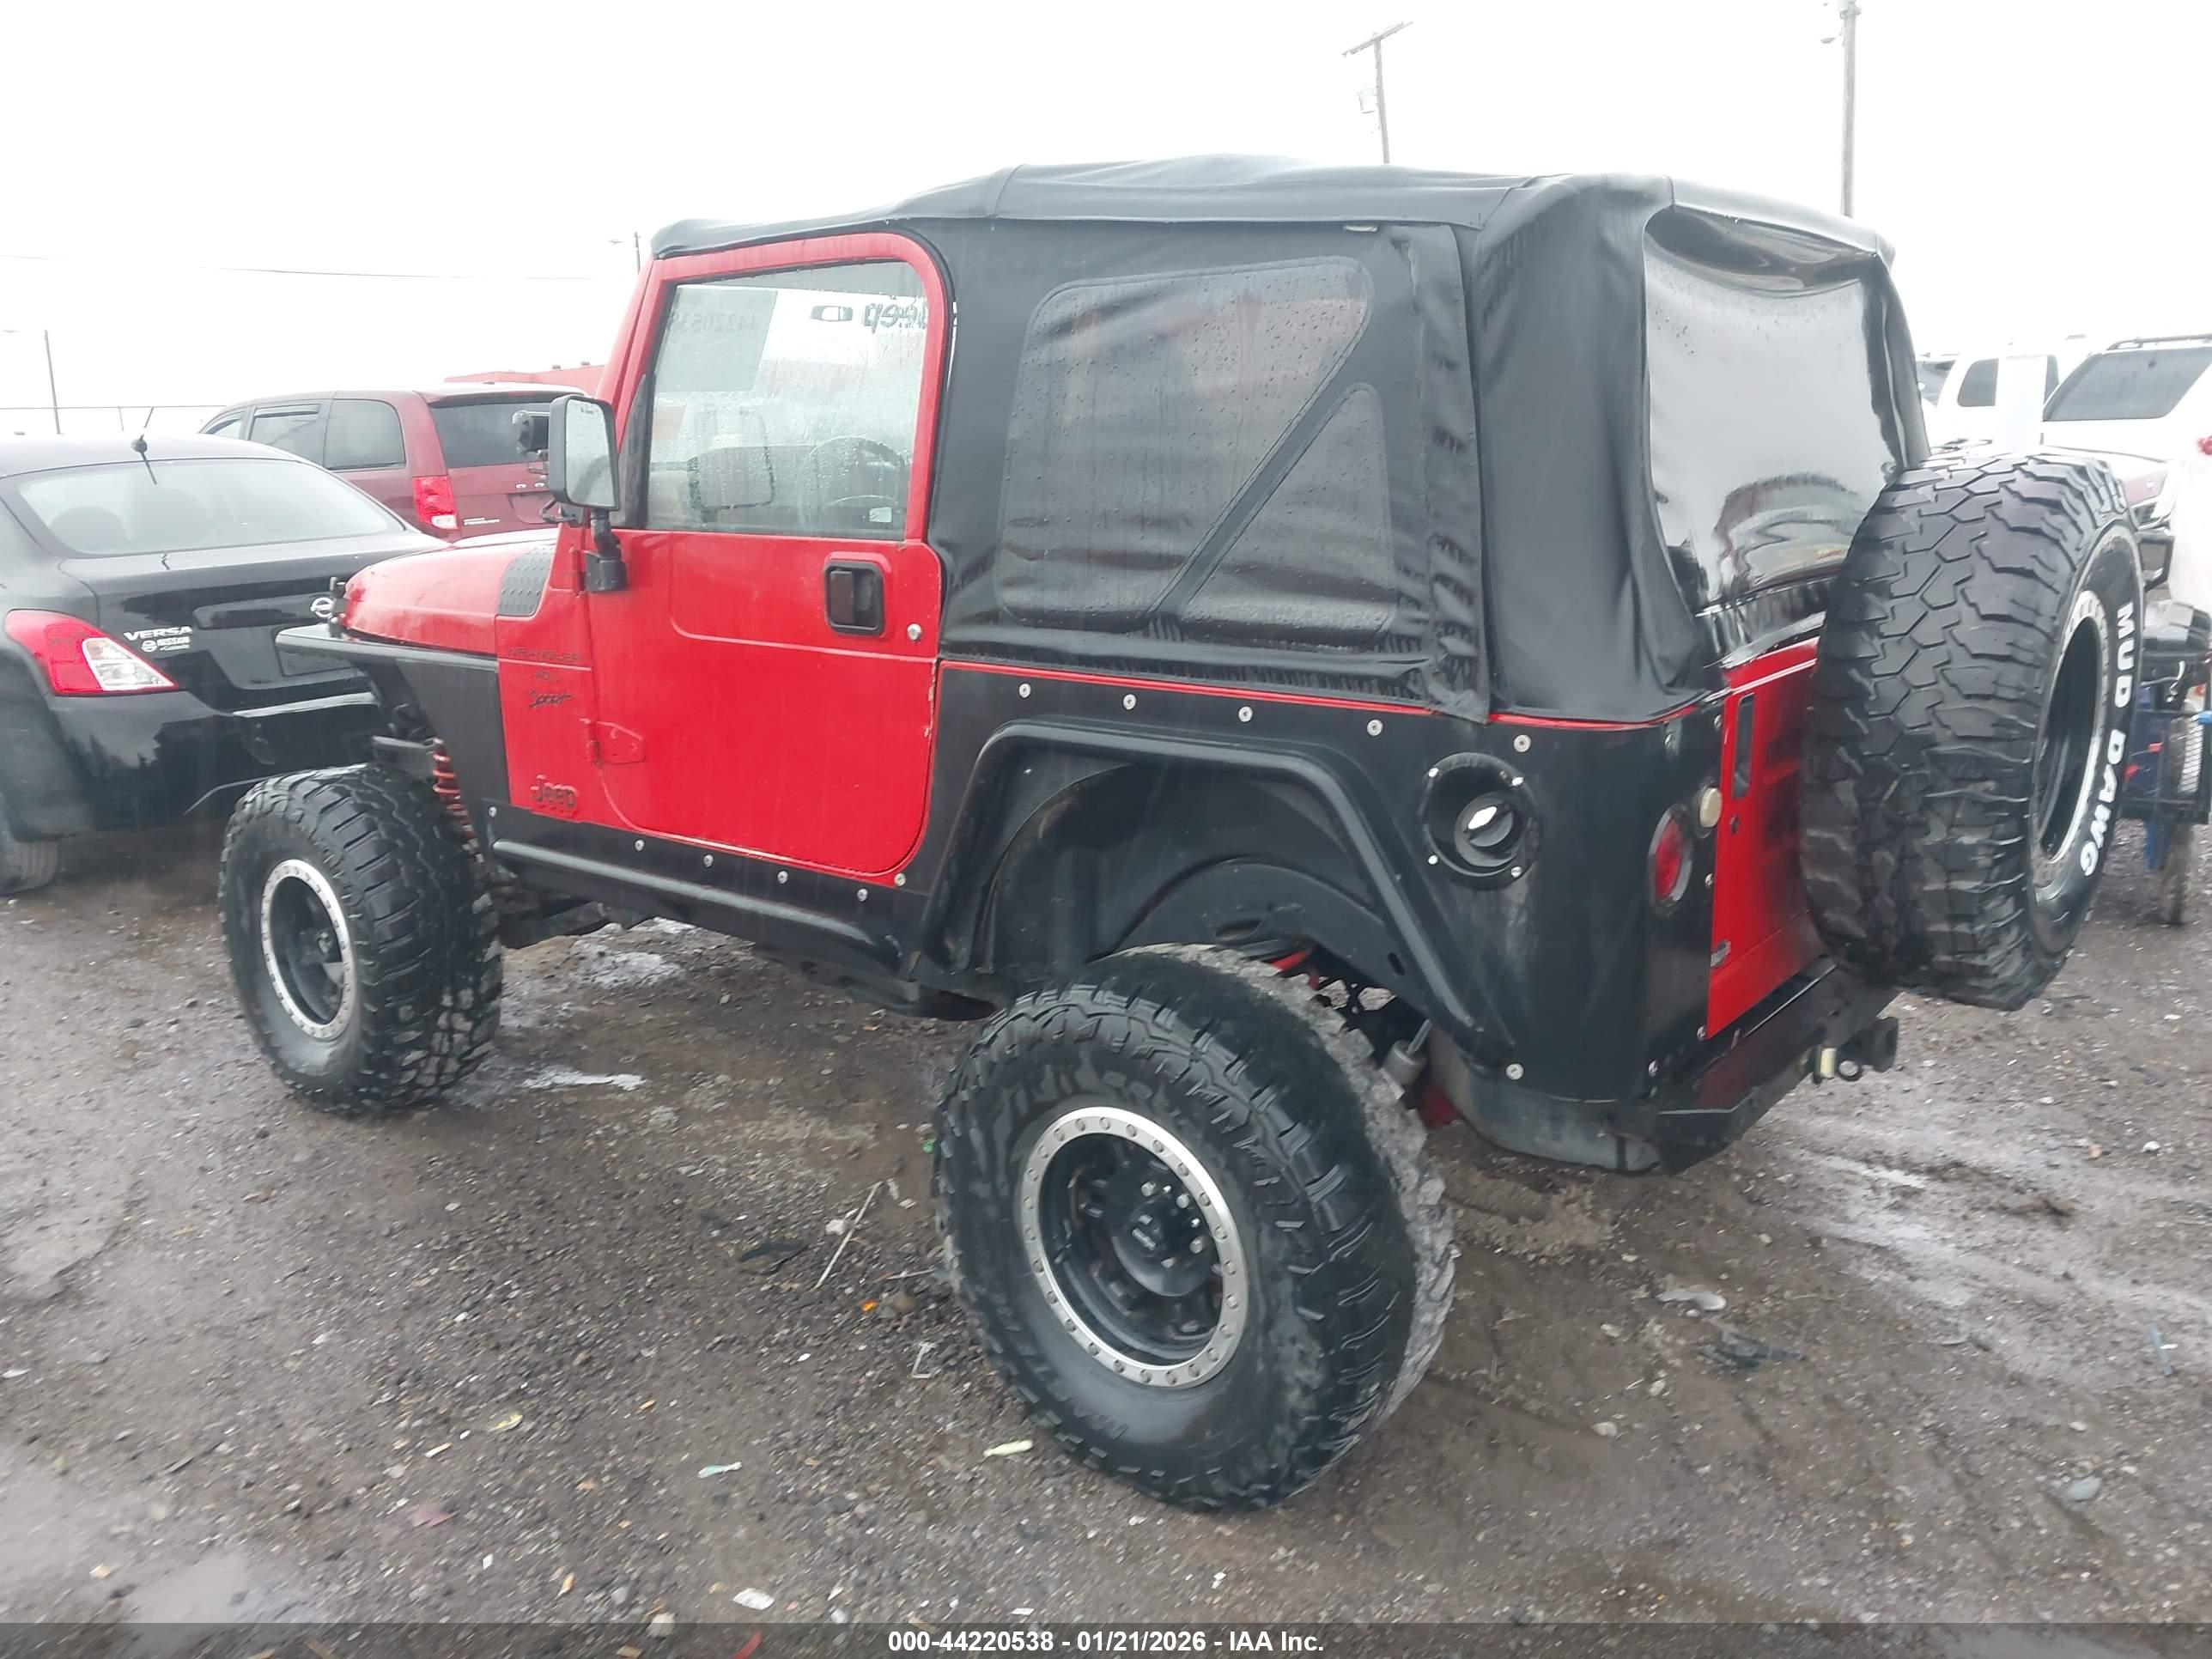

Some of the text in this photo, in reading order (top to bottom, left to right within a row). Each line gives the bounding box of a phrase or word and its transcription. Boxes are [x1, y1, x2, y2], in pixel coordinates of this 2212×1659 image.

[123, 626, 192, 641] VERSA
[2080, 601, 2136, 877] MUD DAWG
[529, 775, 578, 811] Jeep
